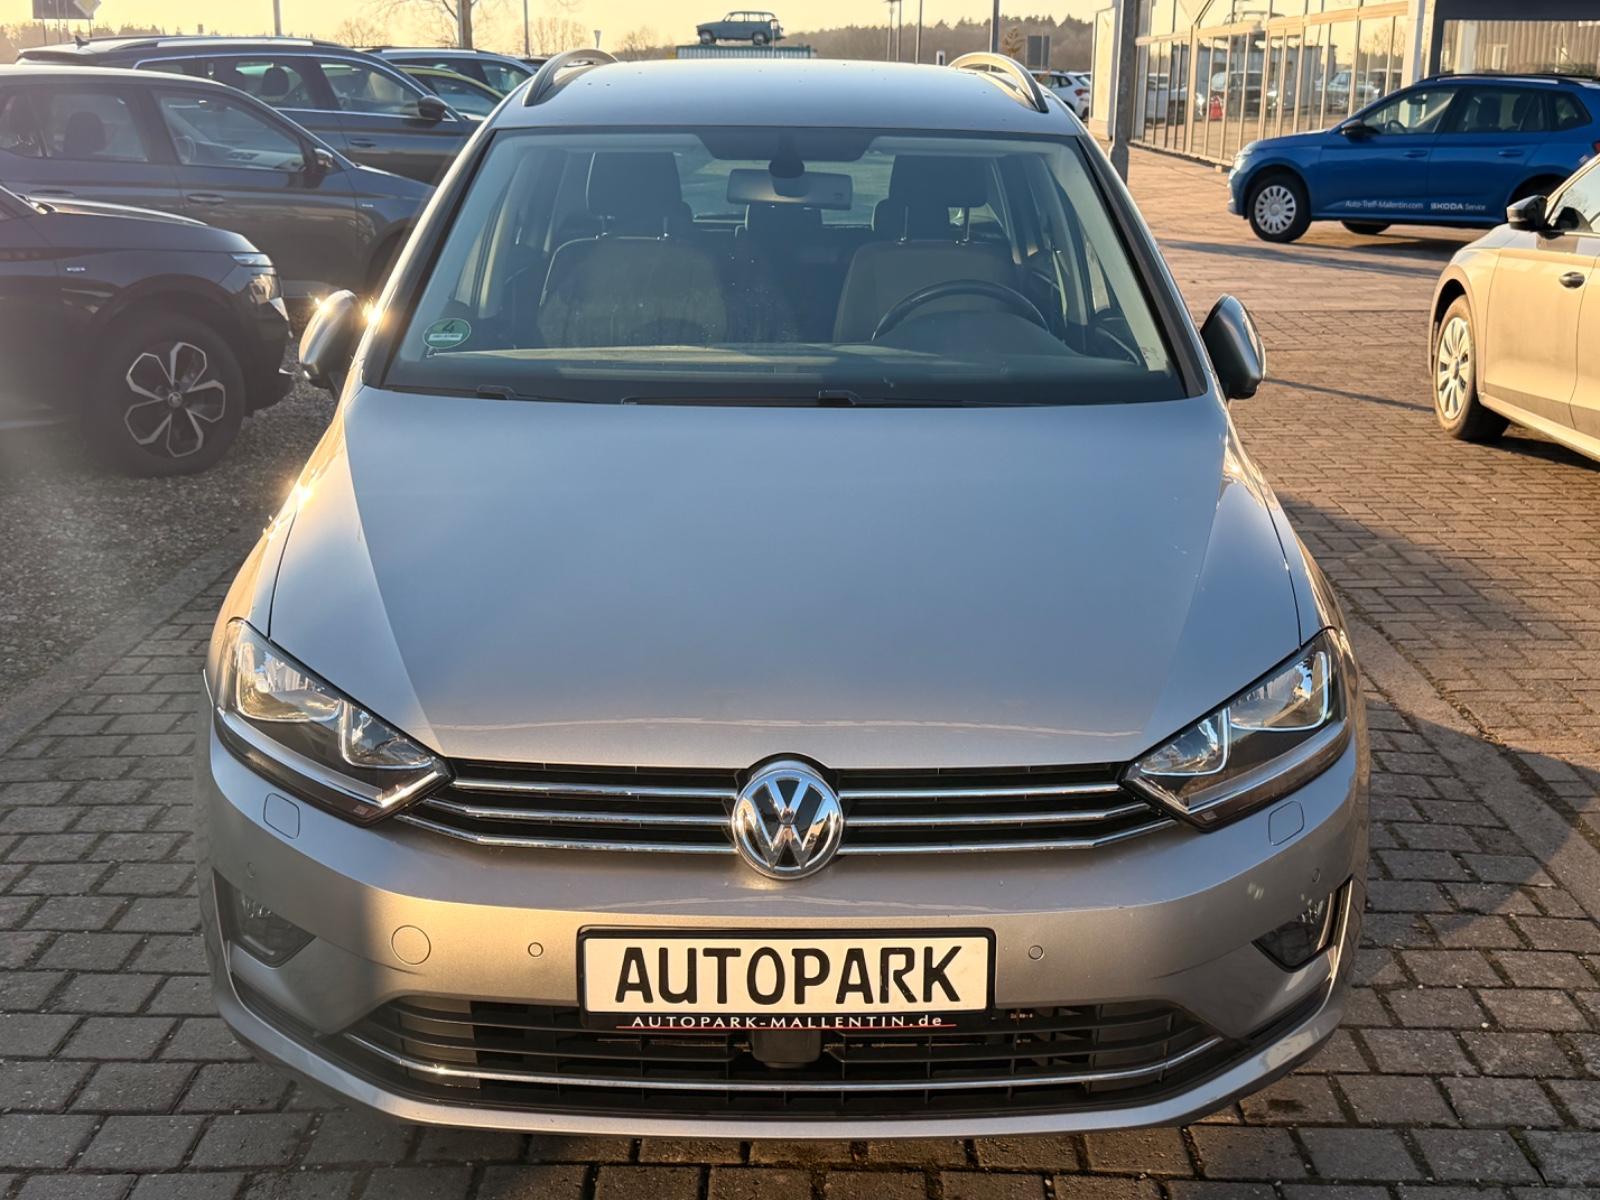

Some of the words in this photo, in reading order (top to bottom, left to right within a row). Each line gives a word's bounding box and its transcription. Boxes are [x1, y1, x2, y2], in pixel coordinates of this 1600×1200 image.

[1465, 203, 1486, 211] Service
[442, 320, 456, 334] 4
[615, 946, 962, 1005] AUTOPARK
[632, 1015, 942, 1029] AUTOPARK-MALLENTIN.de
